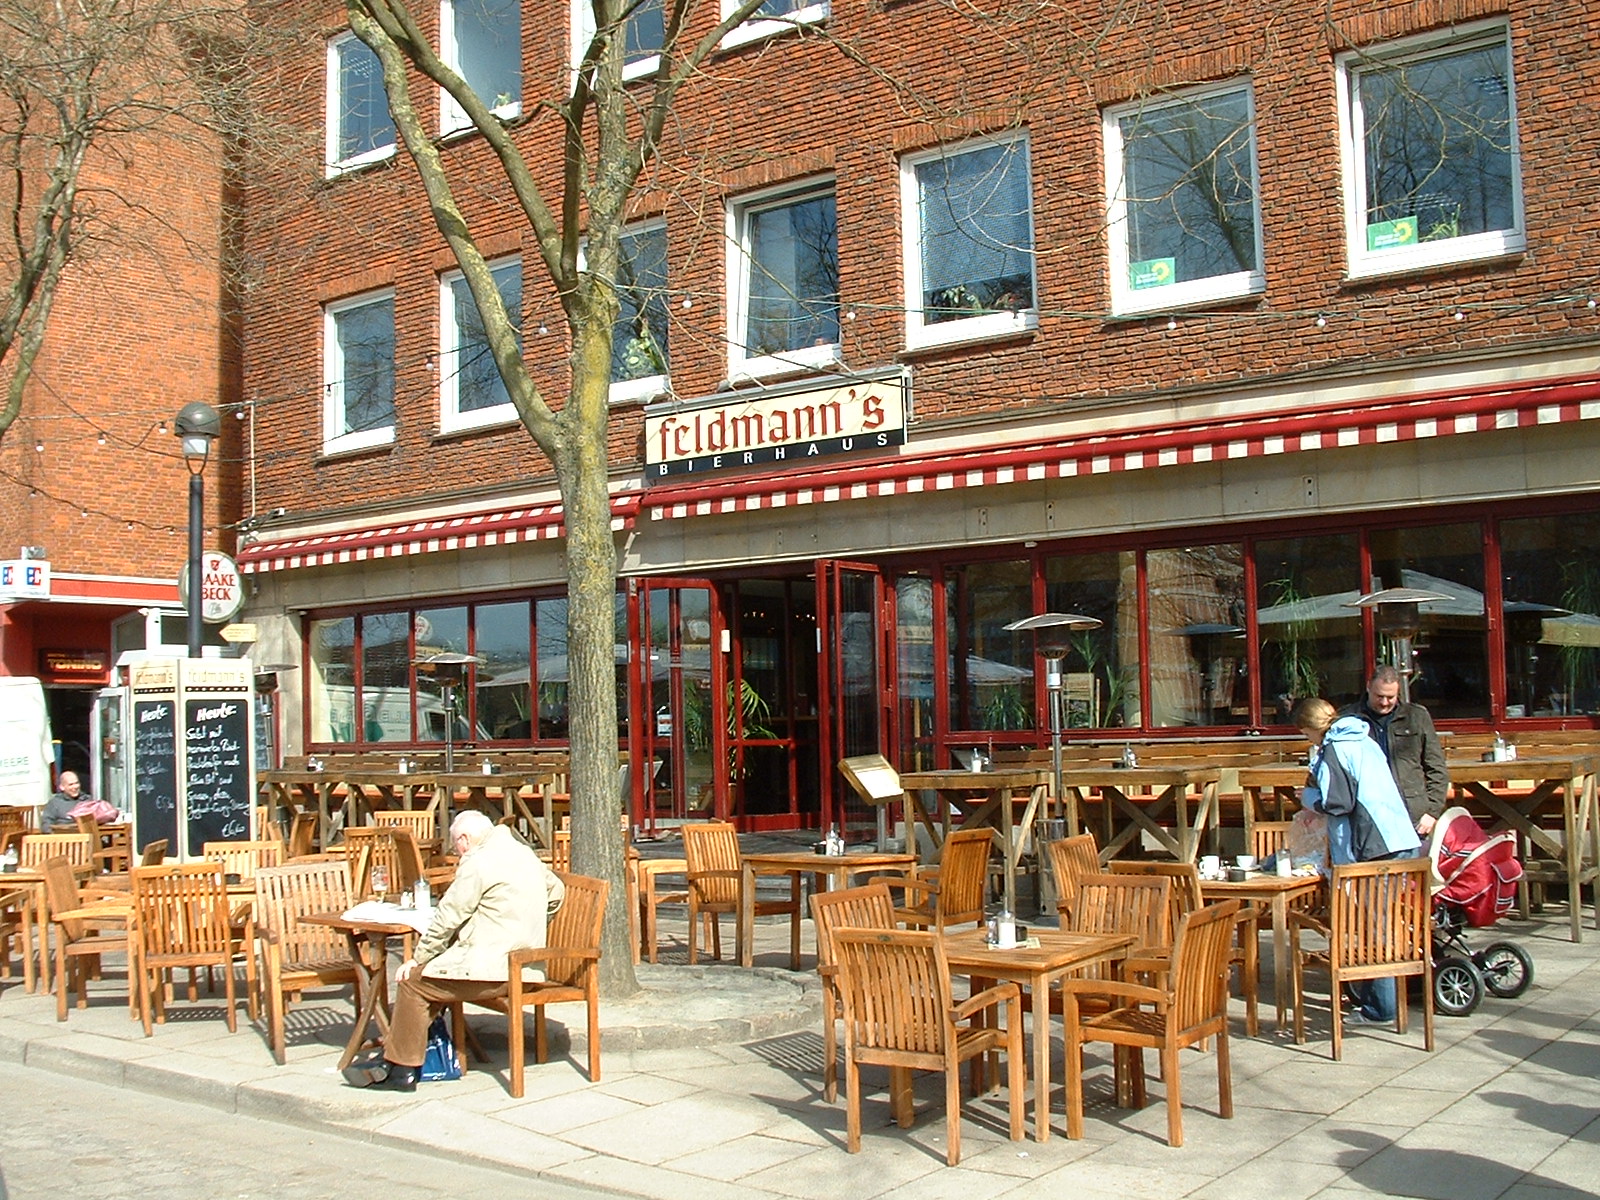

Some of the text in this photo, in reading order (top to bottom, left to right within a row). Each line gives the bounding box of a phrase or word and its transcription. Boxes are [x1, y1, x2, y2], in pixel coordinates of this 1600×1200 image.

[659, 432, 888, 475] BIERHAUS
[203, 573, 236, 587] AAKE
[202, 587, 232, 601] BECK
